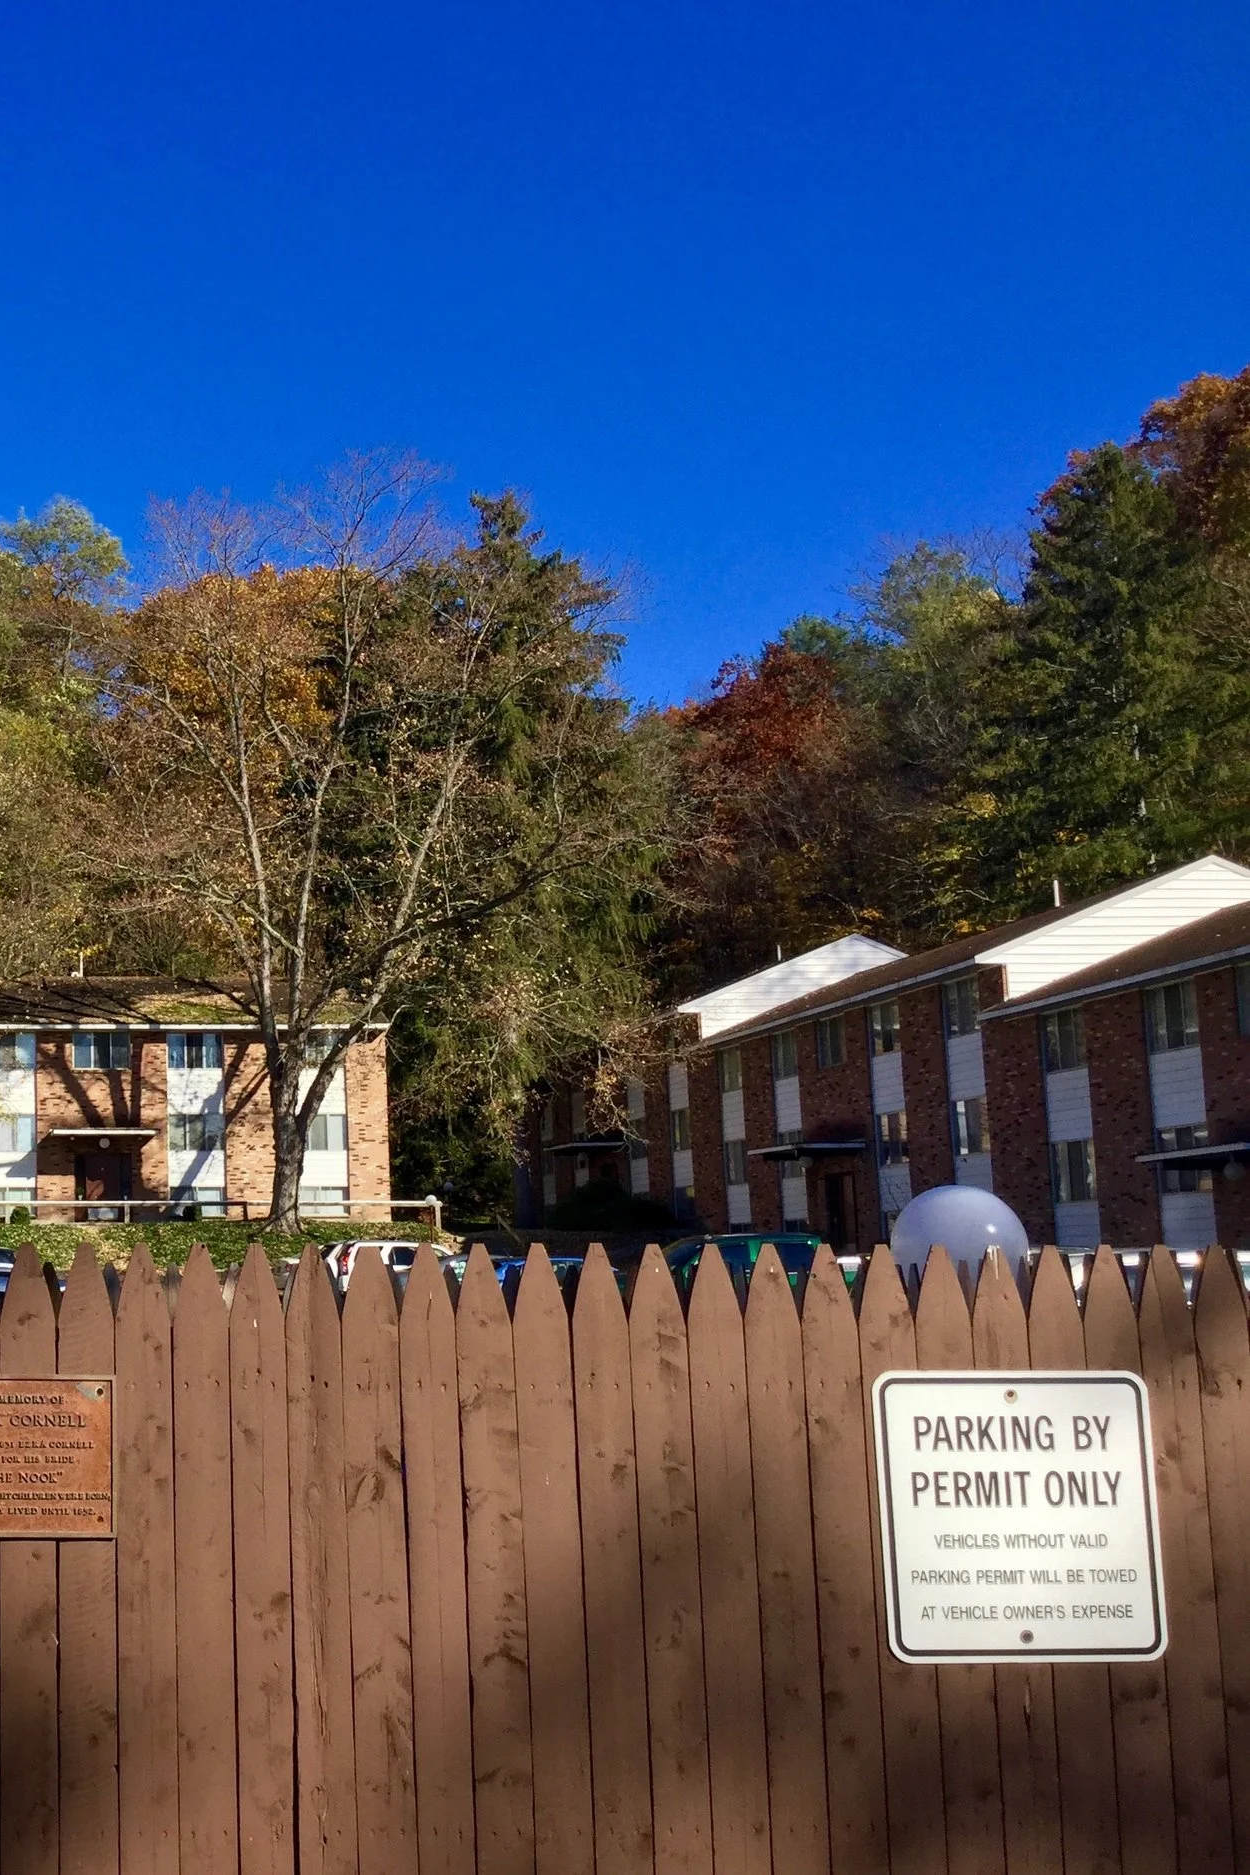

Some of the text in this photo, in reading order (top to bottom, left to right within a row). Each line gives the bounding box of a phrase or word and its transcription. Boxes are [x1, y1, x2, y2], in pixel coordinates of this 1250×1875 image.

[0, 1394, 46, 1404] MEMORY
[9, 1413, 87, 1428] CORNELL
[913, 1415, 1111, 1451] PARKING BY
[18, 1440, 47, 1449] EZRA
[48, 1440, 95, 1449] CORNELL
[1, 1455, 21, 1464] FOR
[24, 1455, 40, 1464] HIS
[44, 1455, 75, 1464] BRIDE
[11, 1491, 58, 1500] CHILDREN
[58, 1491, 84, 1500] WERE
[910, 1470, 1122, 1507] PERMIT ONLY
[7, 1506, 37, 1515] LIVED
[41, 1507, 70, 1516] UNTIL
[934, 1533, 1108, 1549] VEHICLES WITHOUT VALID
[911, 1568, 1138, 1584] PARKING PERMIT WILL BE TOWED
[921, 1605, 1134, 1620] AT VEHICLE OWNER'S EXPENSE
